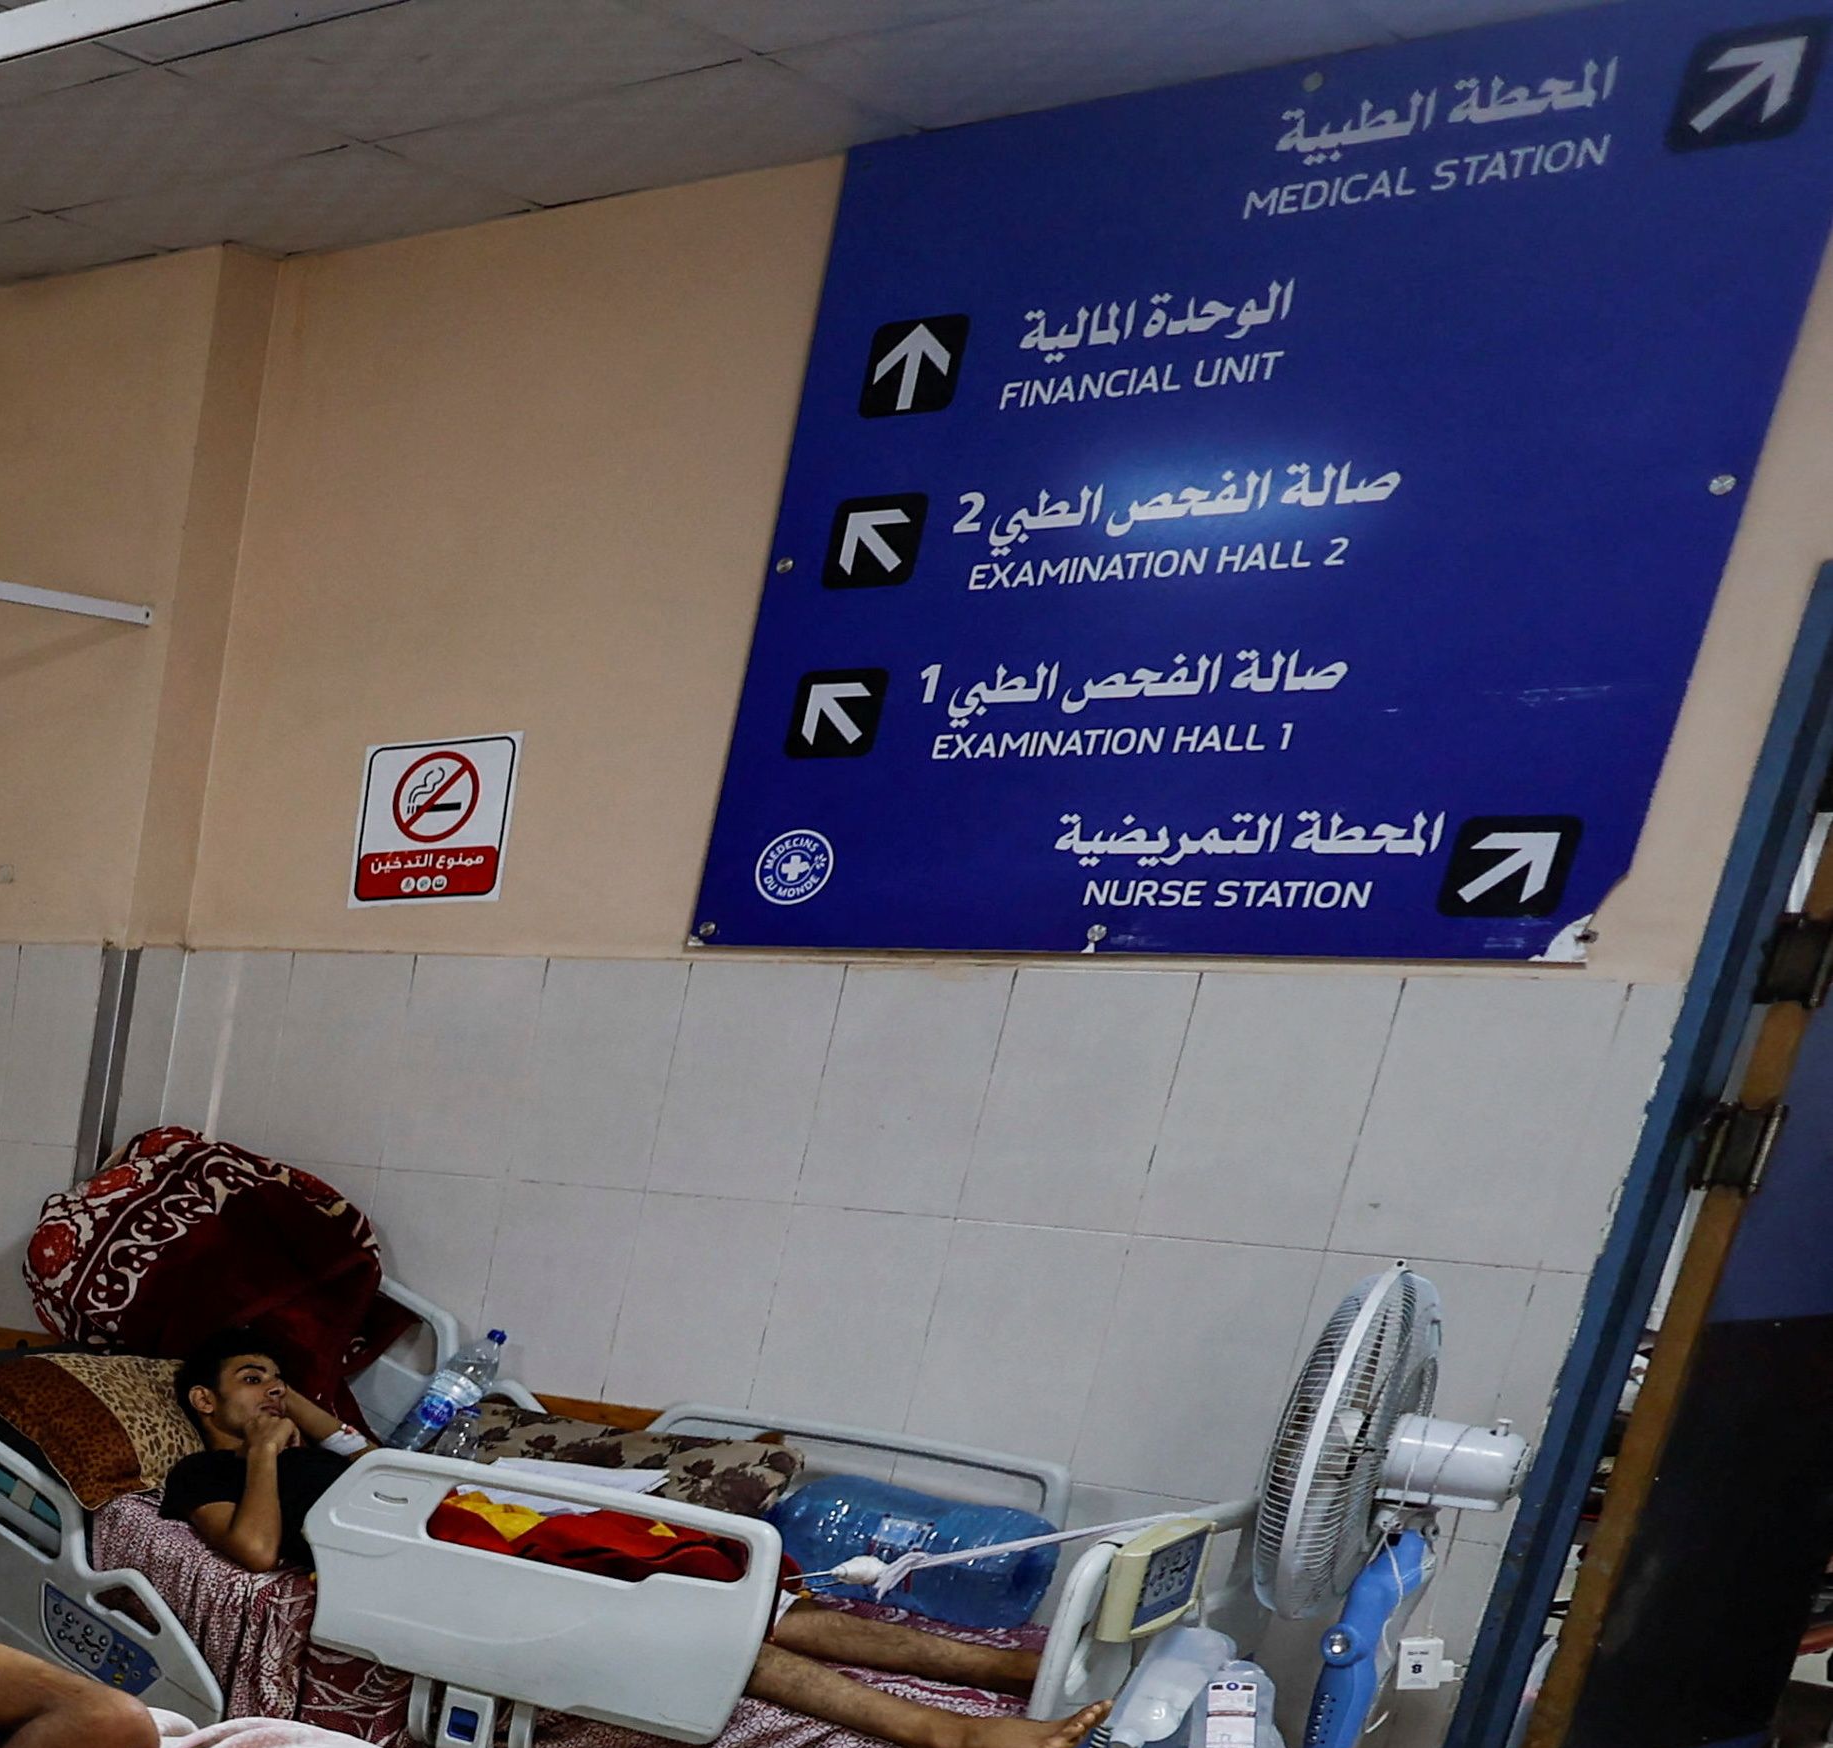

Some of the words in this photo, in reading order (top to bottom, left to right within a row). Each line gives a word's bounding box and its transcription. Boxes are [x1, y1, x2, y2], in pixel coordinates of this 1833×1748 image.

[1448, 56, 1618, 124] المحطة
[1275, 88, 1437, 166] الطبية
[1242, 167, 1416, 219] MEDICAL
[1430, 134, 1611, 191] STATION
[1019, 298, 1137, 364] المالية
[1143, 277, 1295, 339] الوحدة
[999, 364, 1181, 410] FINANCIAL
[1194, 351, 1285, 388] UNIT
[1105, 468, 1273, 538] الفحص
[1280, 461, 1402, 508] صالة
[952, 492, 986, 534] 2
[988, 483, 1104, 559] الطبي
[967, 546, 1209, 590] EXAMINATION
[1217, 538, 1312, 575] HALL
[1322, 537, 1350, 566] 2
[920, 663, 942, 704] 1
[947, 661, 1061, 729] الطبي
[1061, 652, 1223, 714] الفحص
[1230, 648, 1349, 693] صالة
[931, 726, 1165, 760] EXAMINATION
[1172, 722, 1266, 753] HALL
[1279, 722, 1294, 751] 1
[764, 837, 820, 869] MEDECINS
[1053, 811, 1284, 868] التمريضية
[1291, 810, 1446, 857] المحطة
[370, 853, 434, 875] التدخين
[435, 852, 485, 870] ممنوع
[763, 875, 778, 891] DU
[776, 874, 820, 898] MONDE
[1082, 879, 1208, 907] NURSE
[1213, 879, 1373, 909] STATION
